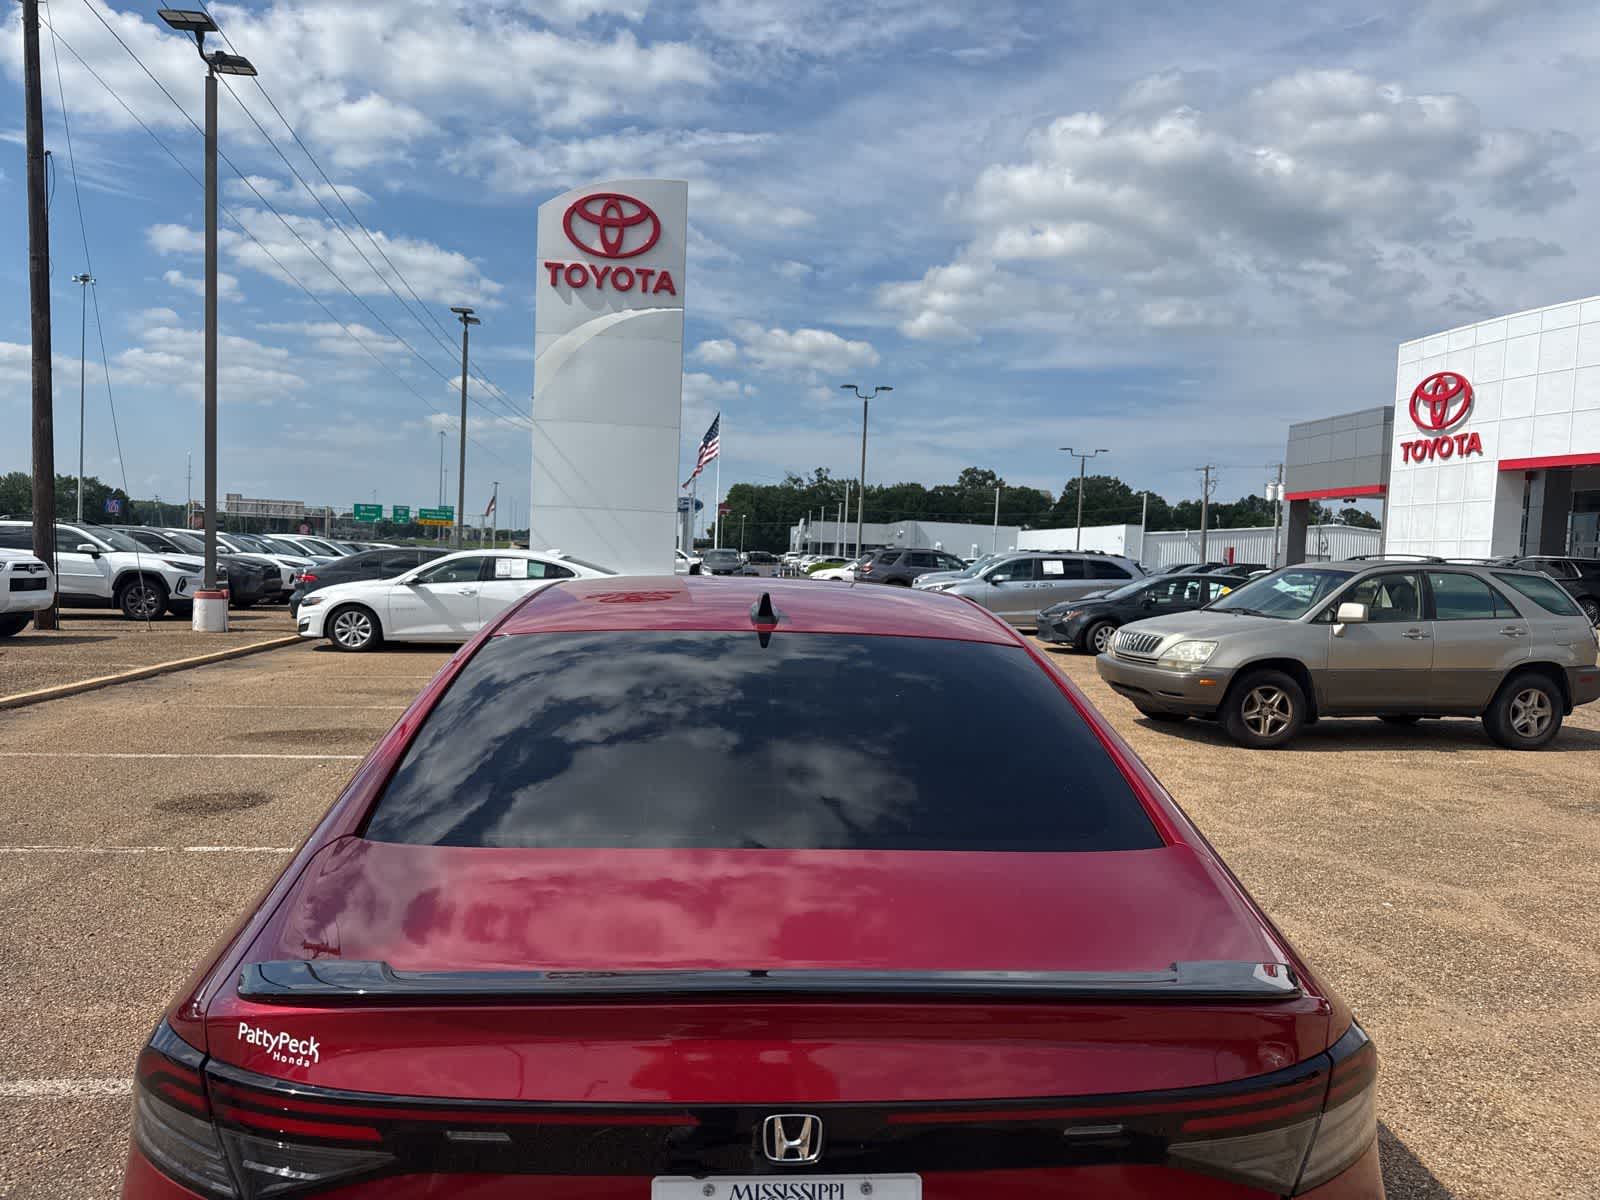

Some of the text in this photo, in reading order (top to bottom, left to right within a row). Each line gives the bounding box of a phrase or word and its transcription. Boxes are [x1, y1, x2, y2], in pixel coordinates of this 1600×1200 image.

[544, 261, 676, 296] TOYOTA
[1401, 432, 1483, 463] TOYOTA
[272, 1051, 310, 1068] Honda
[729, 1183, 844, 1200] MISSISSIPPI
